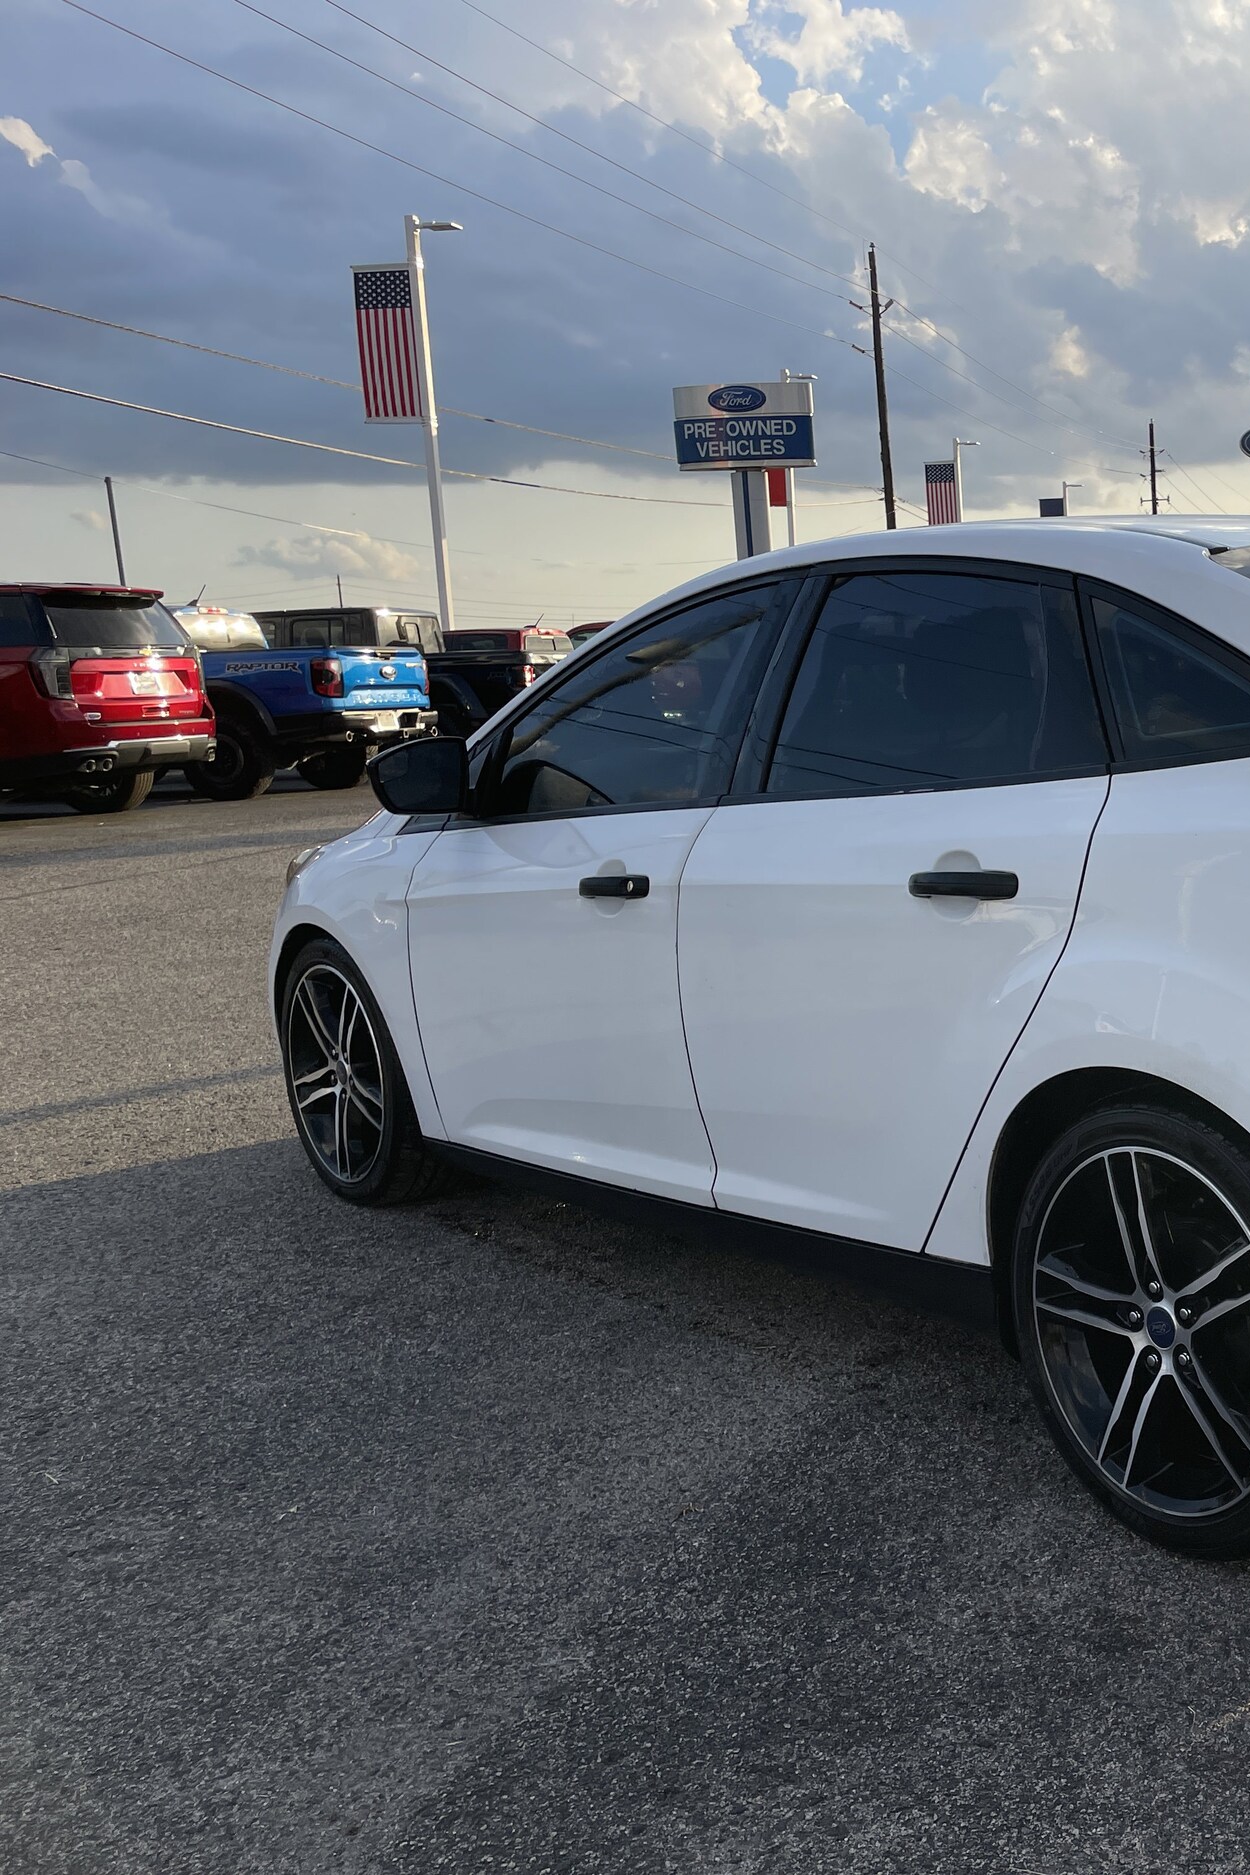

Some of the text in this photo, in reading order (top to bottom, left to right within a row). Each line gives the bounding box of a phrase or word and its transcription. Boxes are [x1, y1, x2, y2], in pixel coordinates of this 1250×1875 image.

[719, 391, 752, 406] Ford
[684, 420, 797, 439] PRE-OWNED
[696, 439, 786, 458] VEHICLES
[226, 661, 302, 676] RAPTOR
